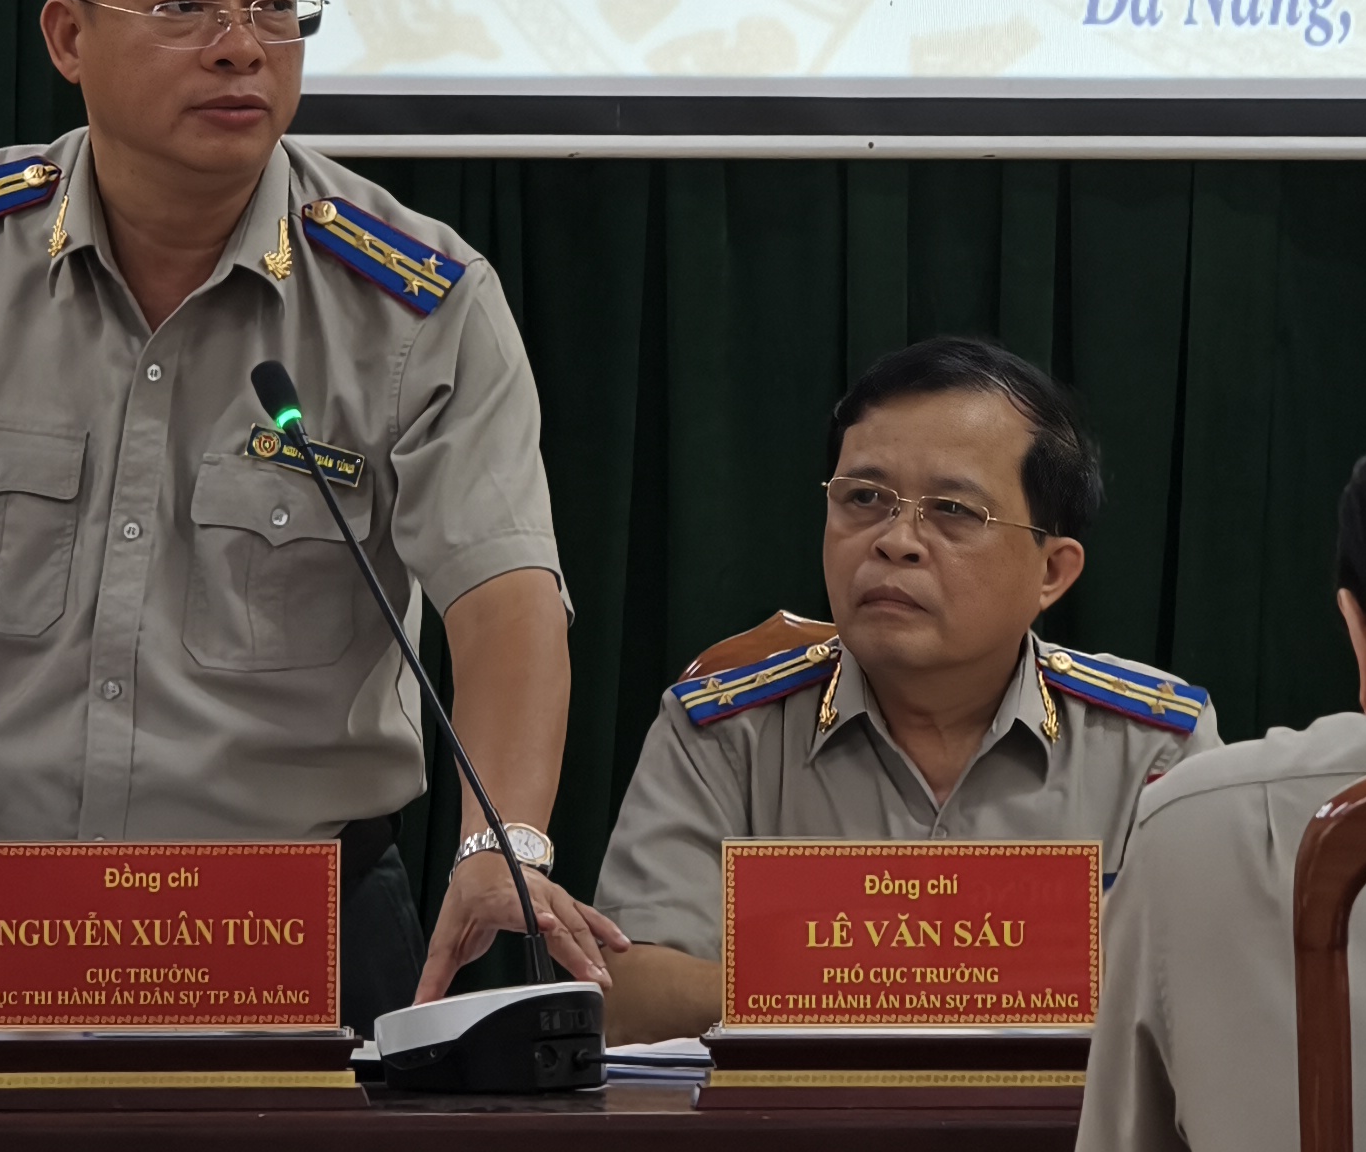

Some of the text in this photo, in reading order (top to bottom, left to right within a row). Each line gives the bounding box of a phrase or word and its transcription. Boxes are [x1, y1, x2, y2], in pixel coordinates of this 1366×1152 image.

[105, 863, 199, 892] Đồng chí
[865, 870, 958, 899] Đồng chí
[130, 911, 214, 946] XUÂN
[222, 911, 305, 946] TÙNG
[806, 912, 1026, 948] LÊ VĂN SÁU
[86, 963, 209, 988] CỤC TRƯỞNG
[823, 962, 999, 987] PHÓ CỤC TRƯỞNG
[22, 990, 53, 1005] THI
[57, 986, 106, 1005] HÀNH
[111, 986, 134, 1005] ÁN
[140, 986, 174, 1005] DÂN
[207, 989, 229, 1004] TP
[234, 985, 257, 1004] ĐÀ
[748, 994, 781, 1012] CỤC
[786, 994, 817, 1009] THI
[822, 990, 871, 1008] HÀNH
[876, 990, 900, 1008] ÁN
[905, 990, 940, 1008] DÂN
[974, 993, 997, 1008] TP
[1002, 989, 1025, 1008] ĐÀ
